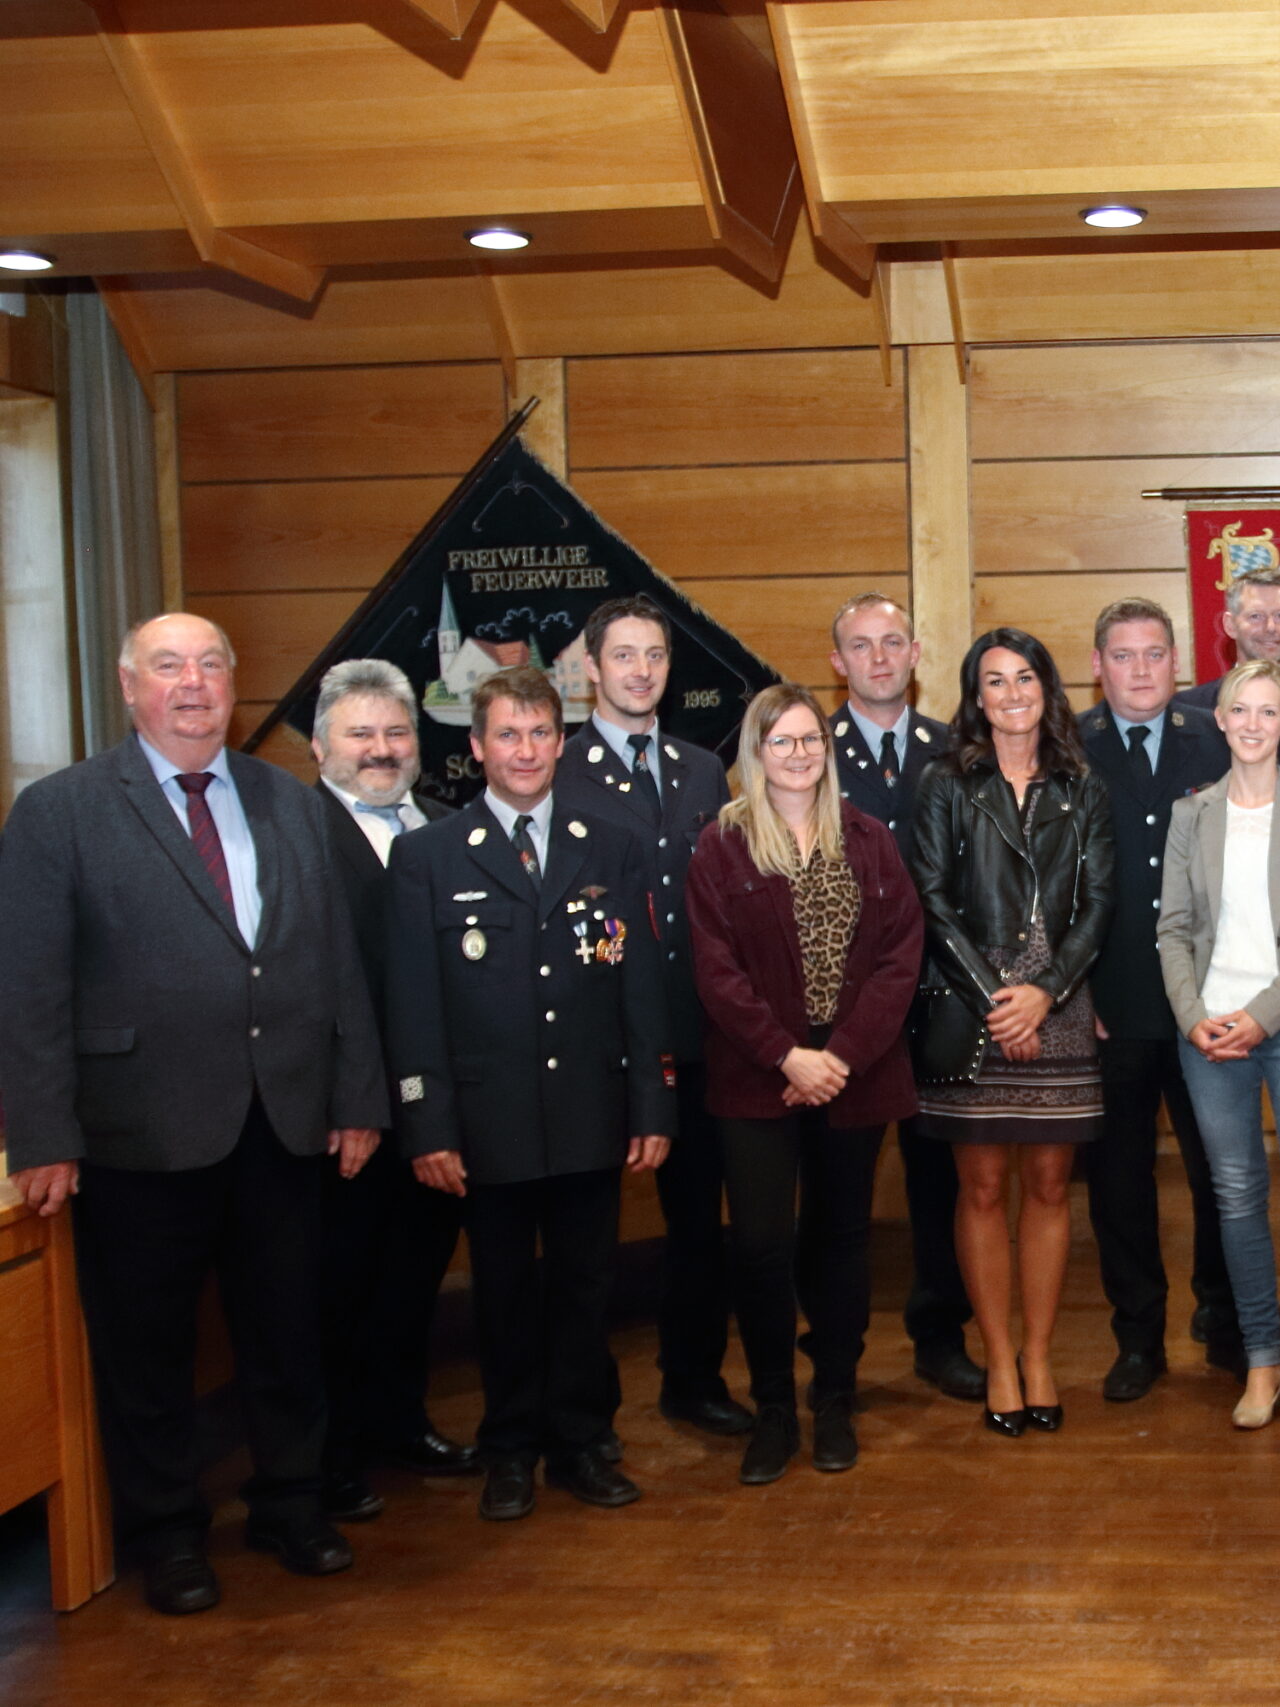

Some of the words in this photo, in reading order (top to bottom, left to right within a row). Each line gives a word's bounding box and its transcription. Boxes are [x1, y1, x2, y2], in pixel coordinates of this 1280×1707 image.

[448, 545, 590, 571] FREIWILLIGE
[470, 566, 609, 593] FEUERWEHR
[683, 688, 721, 709] 1995
